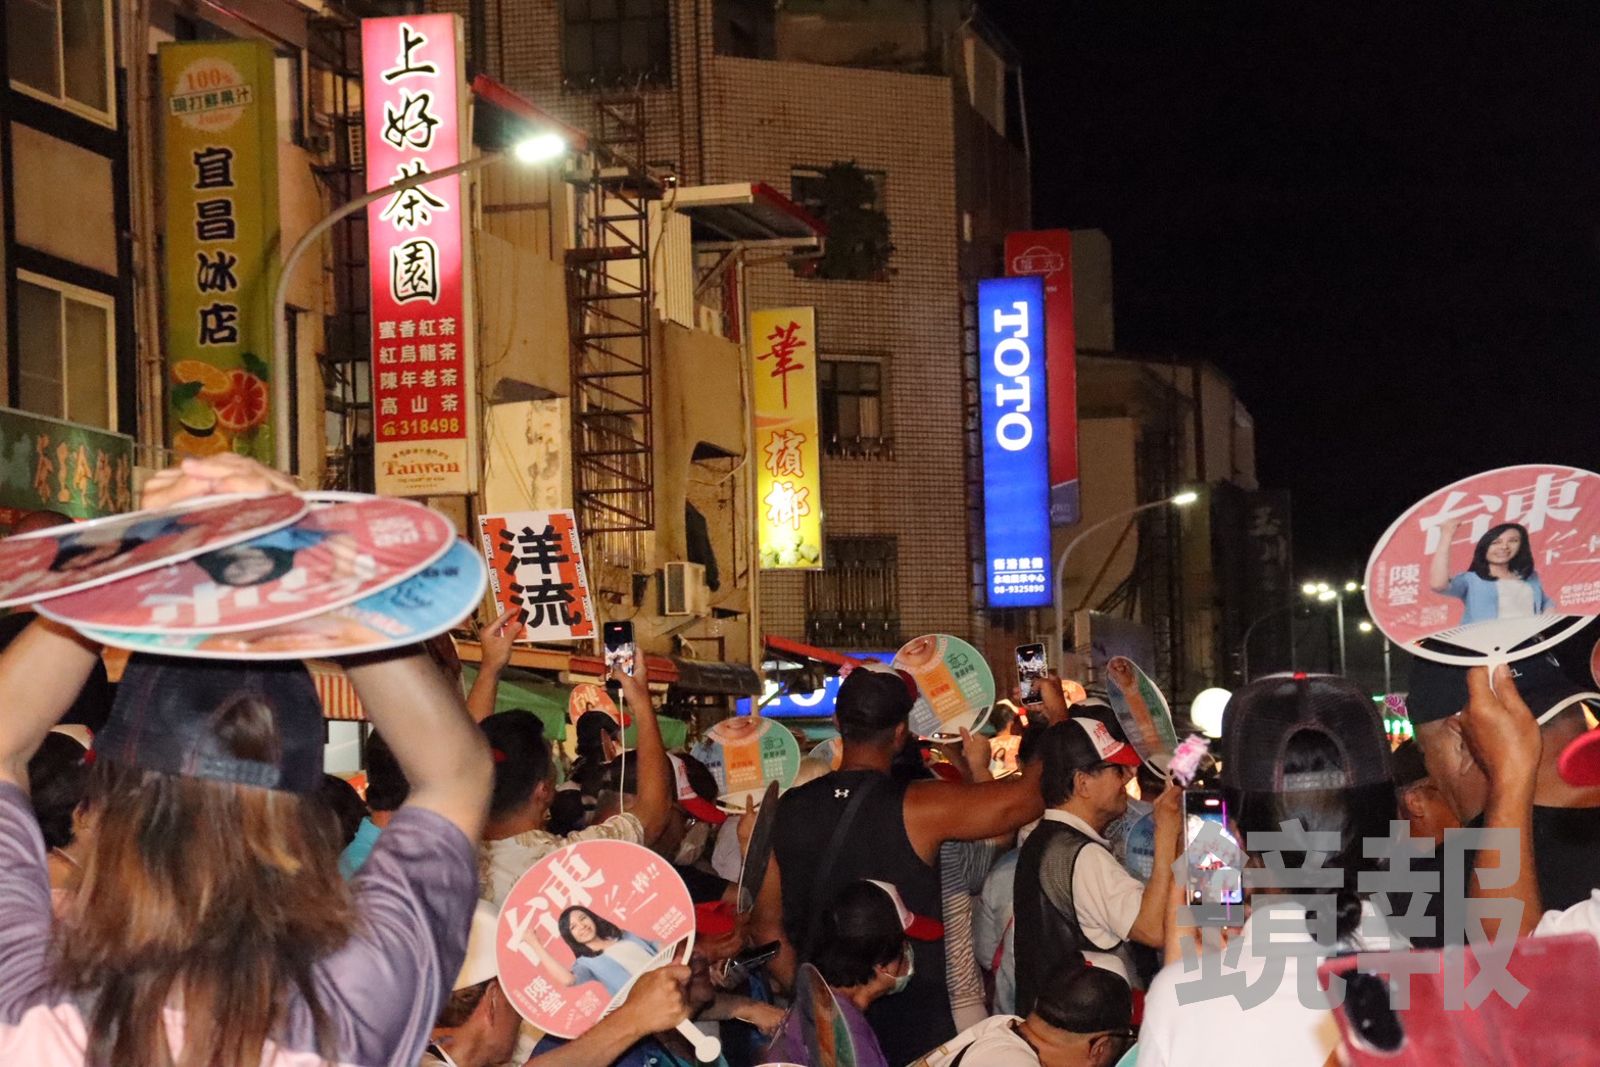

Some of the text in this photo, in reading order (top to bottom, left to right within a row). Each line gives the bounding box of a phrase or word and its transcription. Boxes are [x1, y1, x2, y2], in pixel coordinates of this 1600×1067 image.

[382, 26, 444, 303] 上好茶園
[193, 146, 239, 347] 宜昌冰店
[378, 317, 456, 340] 蜜香紅茶
[379, 342, 457, 365] 紅烏龍茶
[380, 368, 458, 391] 陳年老茶
[993, 301, 1033, 451] TOTO
[381, 394, 459, 416] 高山茶
[400, 418, 460, 435] 318498
[382, 460, 460, 476] Taiwan
[1419, 471, 1590, 555] 台東
[500, 525, 582, 628] 洋流
[505, 844, 605, 967] 台東
